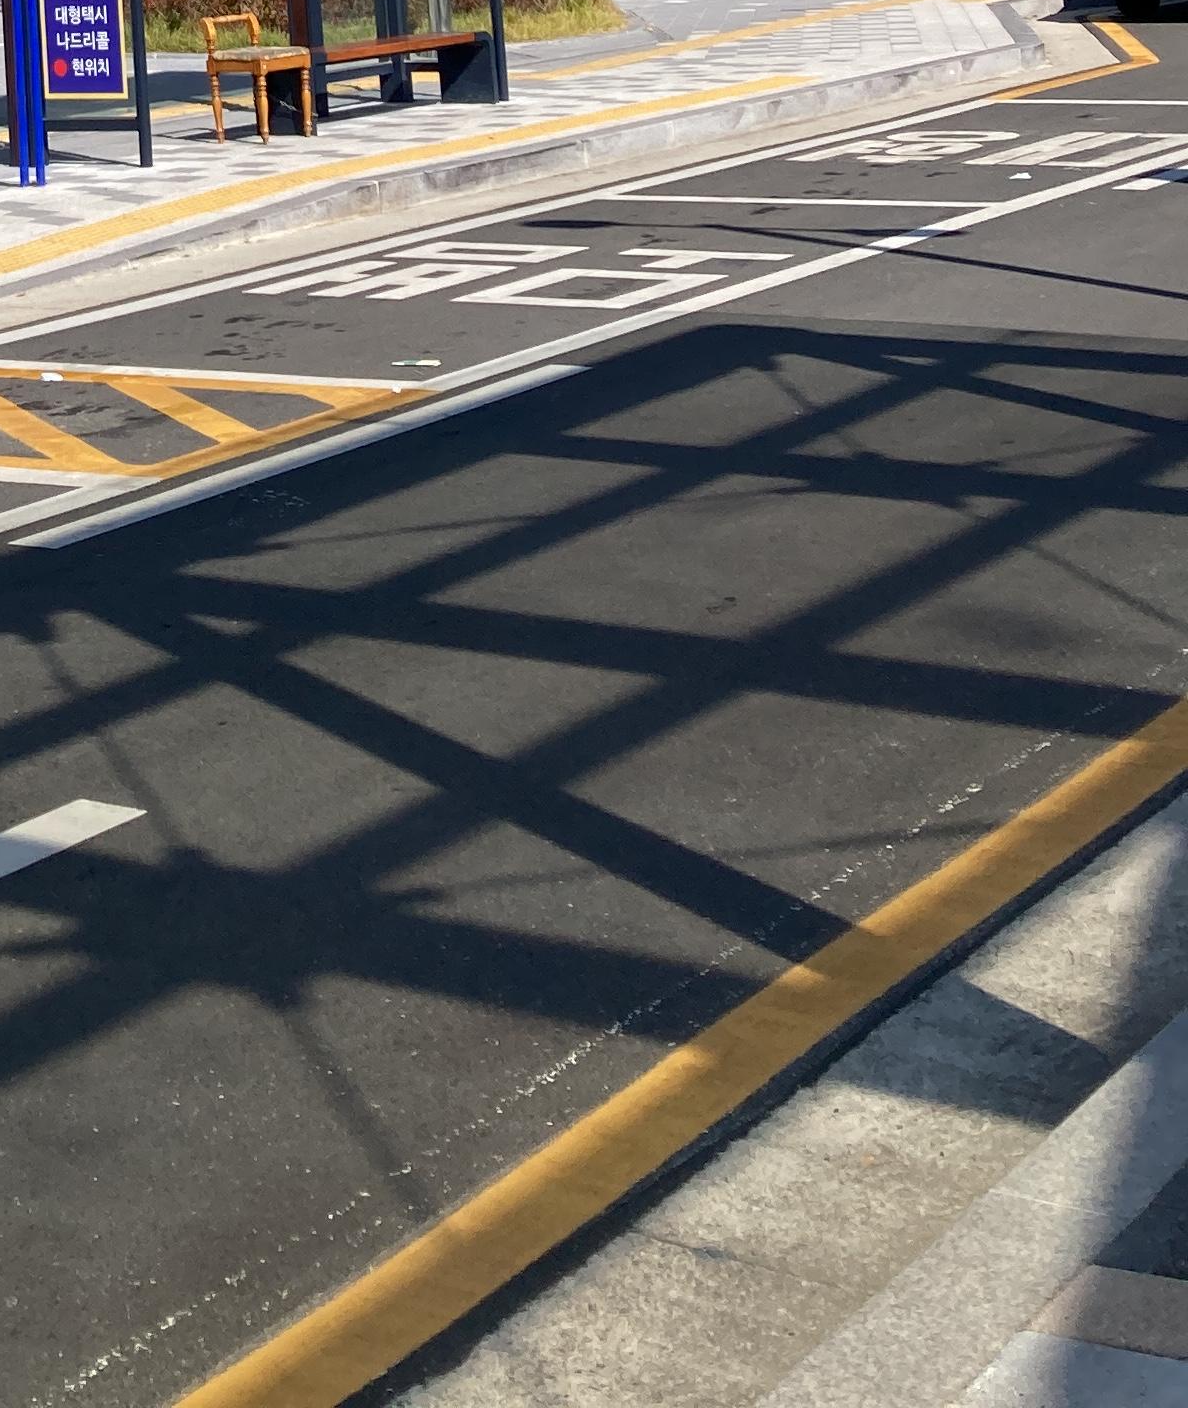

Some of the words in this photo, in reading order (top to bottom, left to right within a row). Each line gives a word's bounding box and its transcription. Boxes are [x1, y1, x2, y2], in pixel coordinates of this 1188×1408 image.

[55, 5, 108, 25] 대형택시
[56, 31, 110, 51] 나드리콜
[72, 58, 110, 77] 현위치
